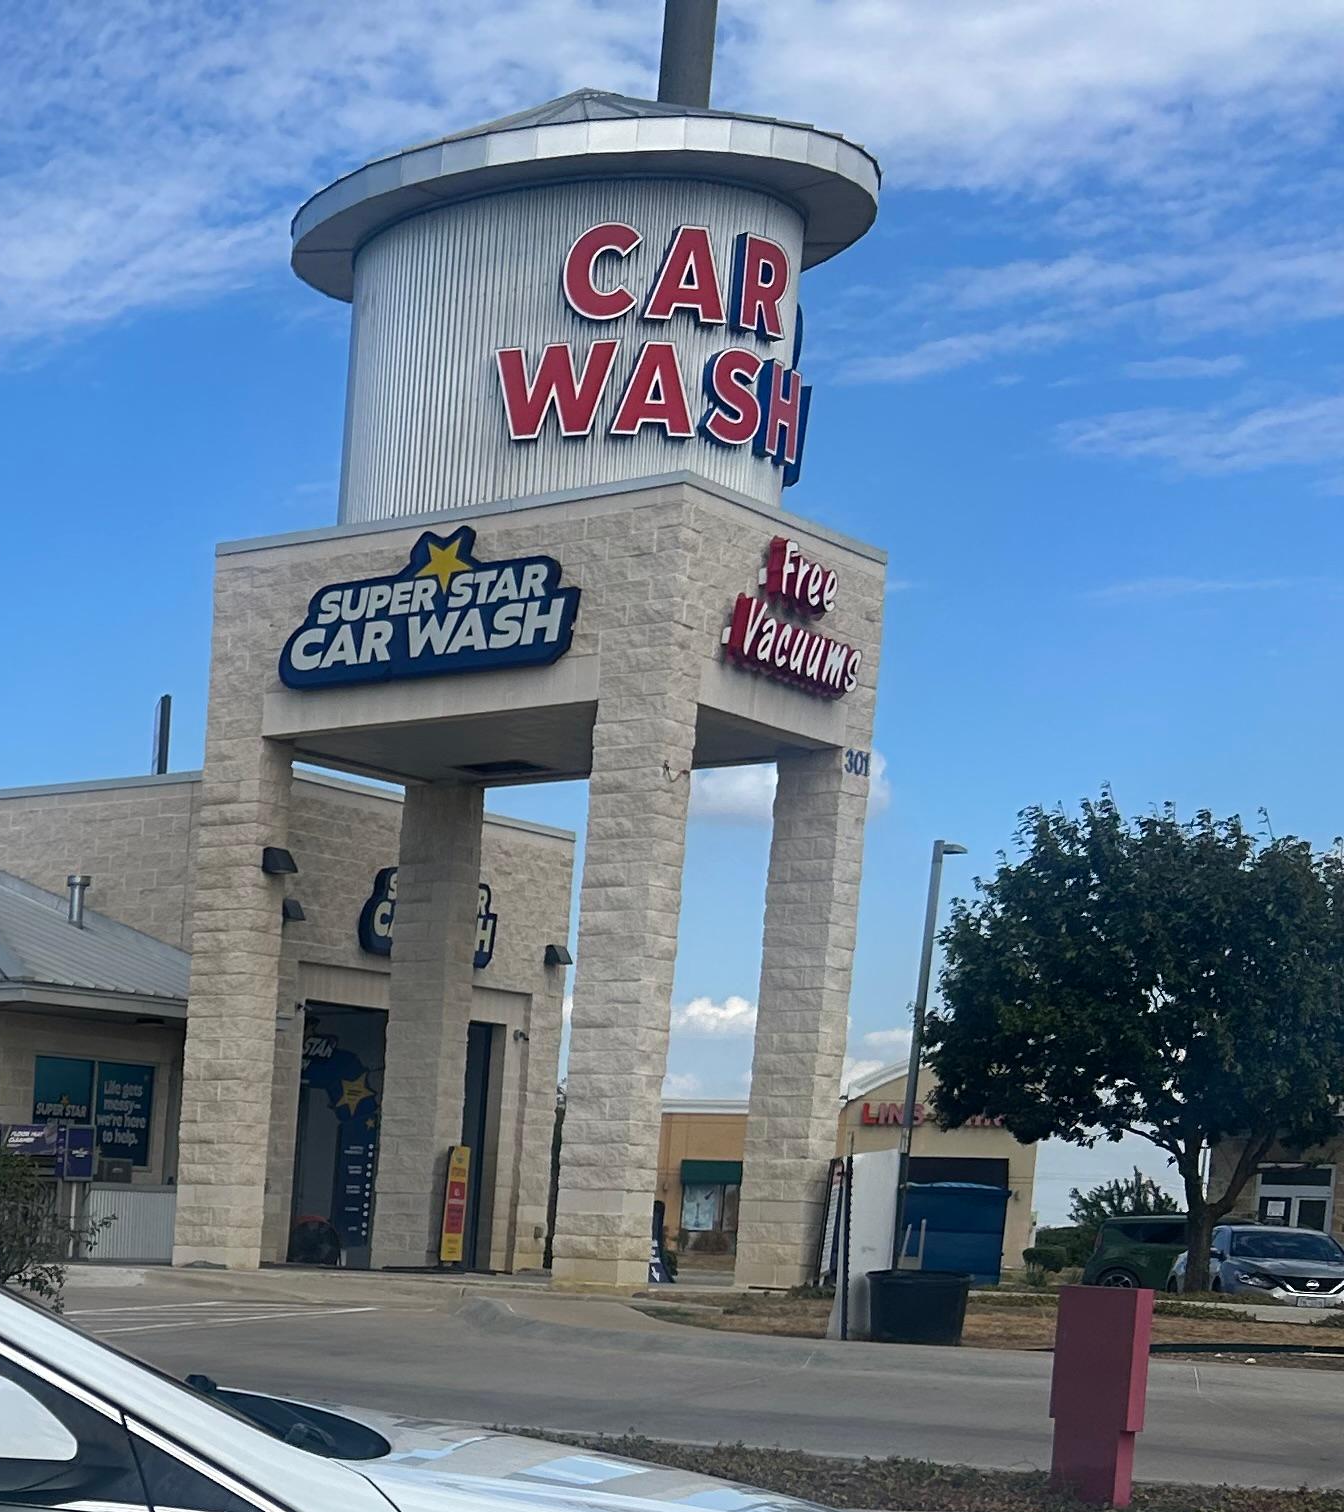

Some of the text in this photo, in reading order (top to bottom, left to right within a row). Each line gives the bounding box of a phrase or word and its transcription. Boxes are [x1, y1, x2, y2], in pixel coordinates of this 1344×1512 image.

[563, 221, 791, 342] CAR
[495, 339, 803, 466] WASH
[317, 563, 548, 625] SUPER STAR
[781, 540, 838, 612] Free
[290, 597, 565, 672] CAR WASH
[742, 597, 862, 692] Vacuums
[844, 748, 871, 777] 301
[35, 1102, 87, 1119] SUPER STAR
[104, 1080, 143, 1098] Life gets
[97, 1114, 146, 1129] we're here
[102, 1130, 139, 1147] to help.
